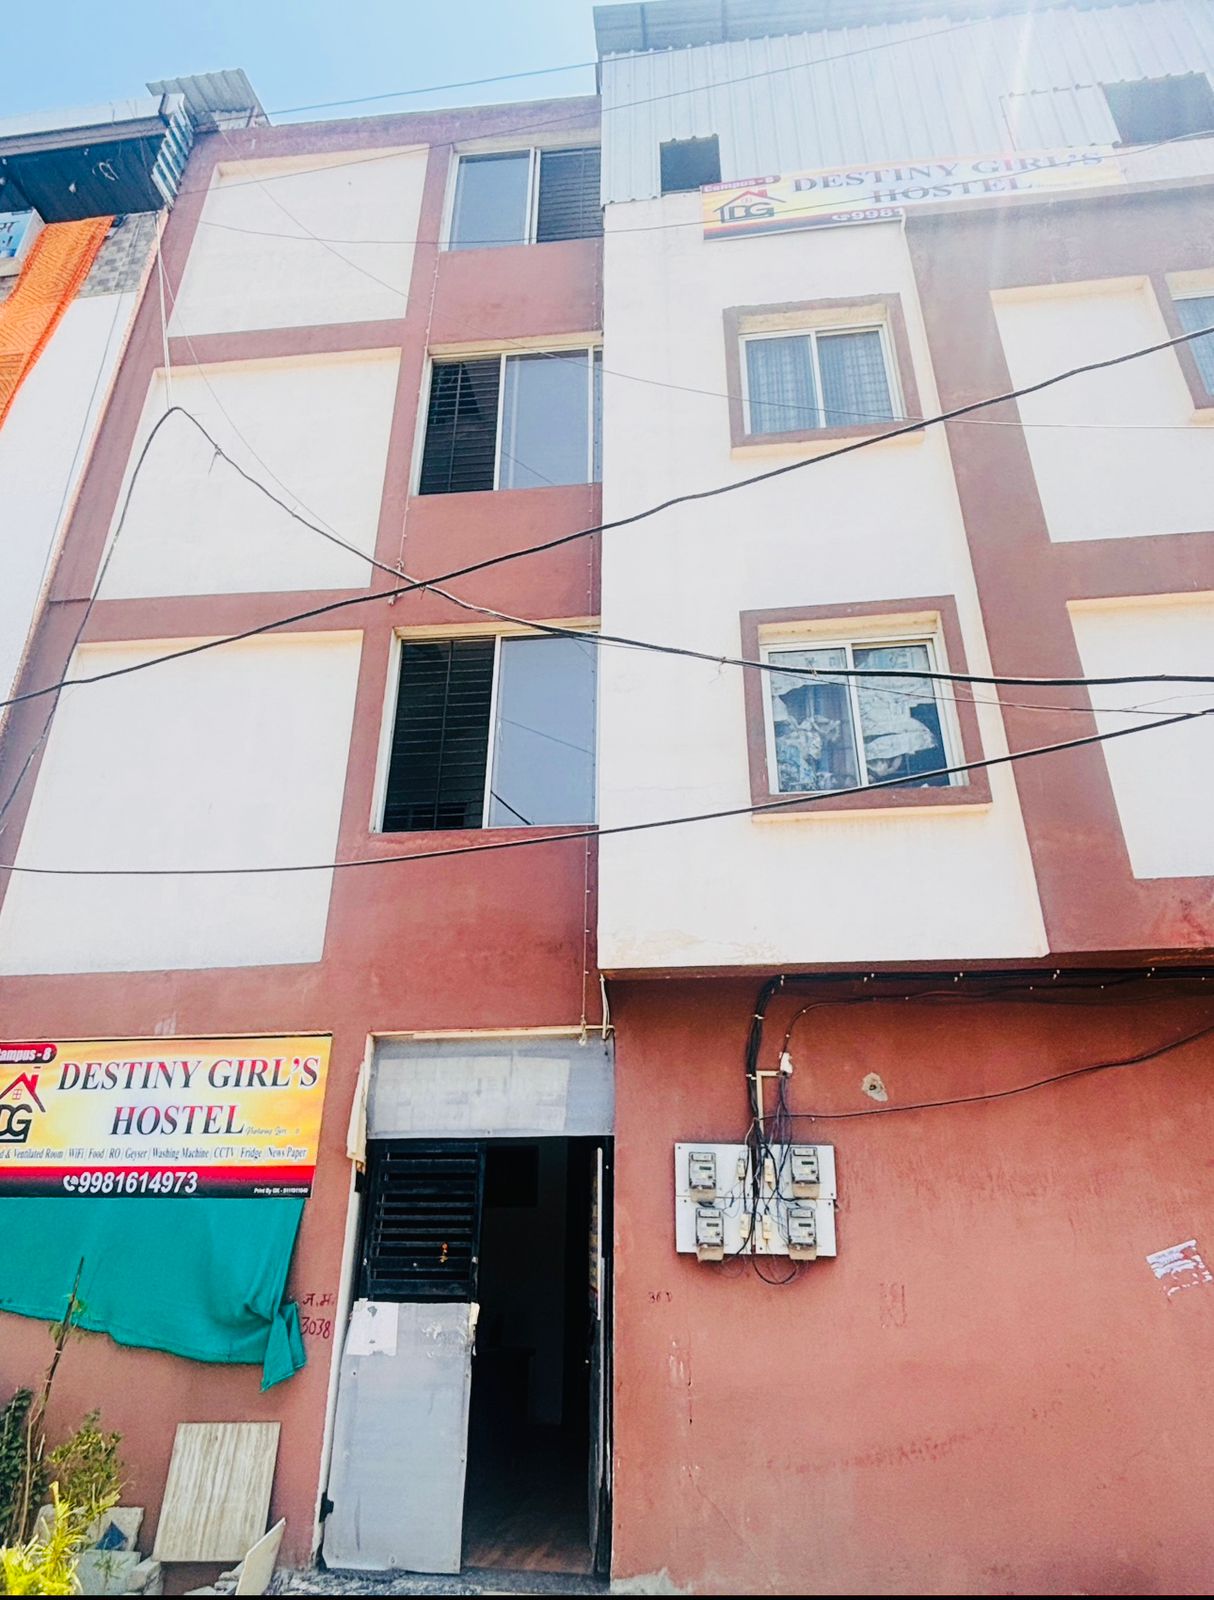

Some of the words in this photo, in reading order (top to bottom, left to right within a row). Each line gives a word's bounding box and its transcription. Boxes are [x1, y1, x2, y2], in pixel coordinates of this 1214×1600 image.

[793, 163, 958, 192] DESTINY
[972, 153, 1104, 174] GIRL'S
[872, 178, 1033, 203] HOSTEL
[0, 1049, 36, 1062] ampus
[42, 1047, 52, 1060] 8
[57, 1061, 202, 1090] DESTINY
[208, 1057, 319, 1088] GIRL'S
[109, 1104, 245, 1135] HOSTEL
[14, 1148, 44, 1158] Ventilated
[45, 1148, 63, 1158] Room
[88, 1148, 104, 1158] Food
[109, 1147, 120, 1158] RO
[125, 1148, 147, 1160] Geyser
[152, 1147, 179, 1159] Washing
[182, 1147, 209, 1158] Machine
[240, 1147, 262, 1158] Fridge
[78, 1171, 198, 1193] 9981614973
[301, 1316, 331, 1339] 3038
